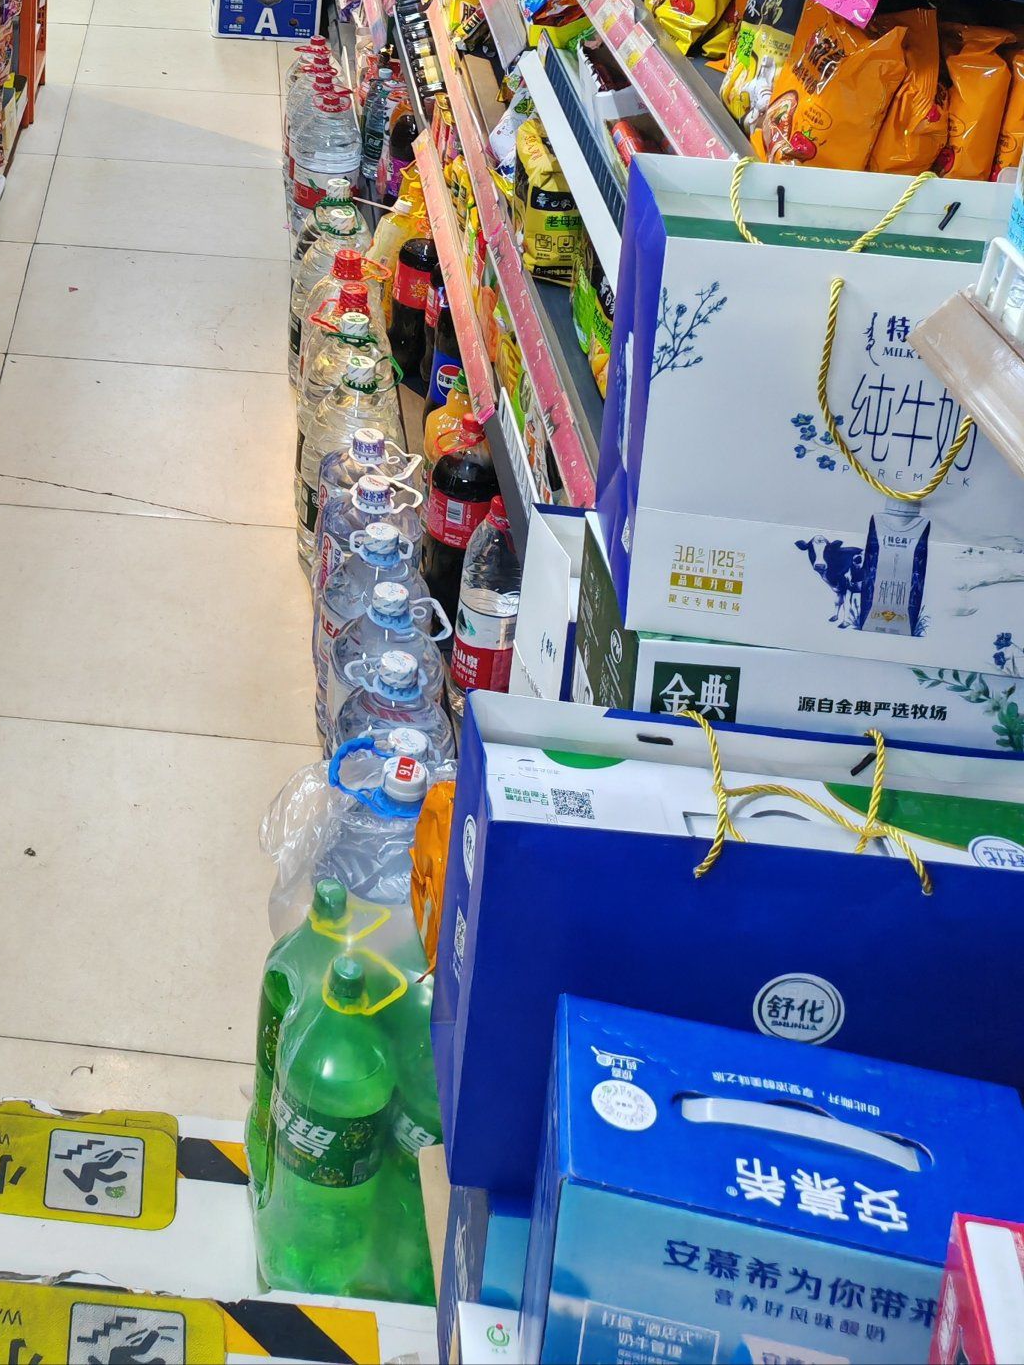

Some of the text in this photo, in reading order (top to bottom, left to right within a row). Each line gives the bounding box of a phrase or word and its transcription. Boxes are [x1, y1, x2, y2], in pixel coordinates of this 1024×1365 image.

[254, 7, 279, 34] A
[882, 347, 915, 358] MILK
[678, 575, 734, 592] 品质升级
[668, 594, 741, 612] 限定专属牧场
[658, 671, 731, 717] 金典
[796, 694, 948, 723] 源自金典严选牧场
[767, 994, 825, 1025] 舒化
[736, 1156, 909, 1234] 安慕希
[663, 1239, 941, 1324] 安慕希为你带来
